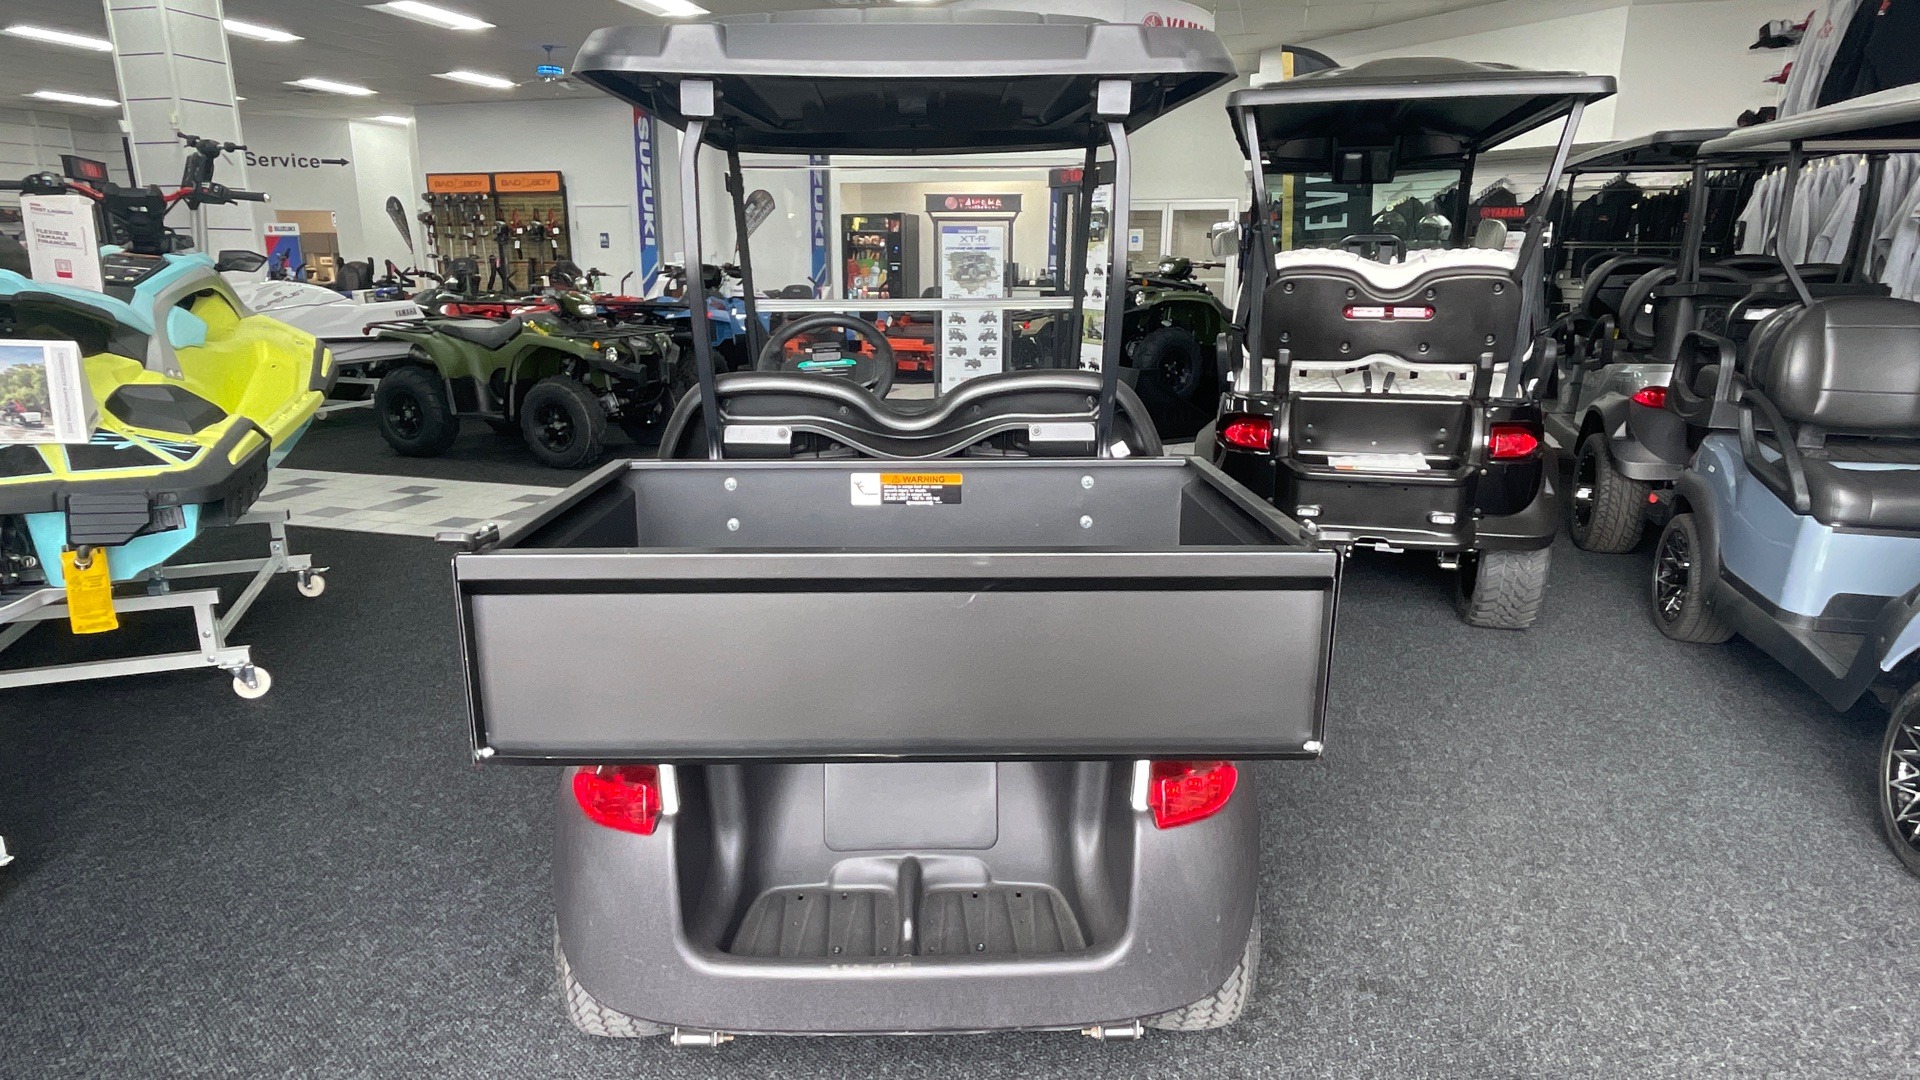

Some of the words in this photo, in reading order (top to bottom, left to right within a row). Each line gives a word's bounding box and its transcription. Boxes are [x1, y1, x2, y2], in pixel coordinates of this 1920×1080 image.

[245, 151, 320, 168] Service
[637, 115, 656, 246] SUZUKI
[960, 235, 987, 243] XT-R
[395, 308, 417, 318] YAMAHA
